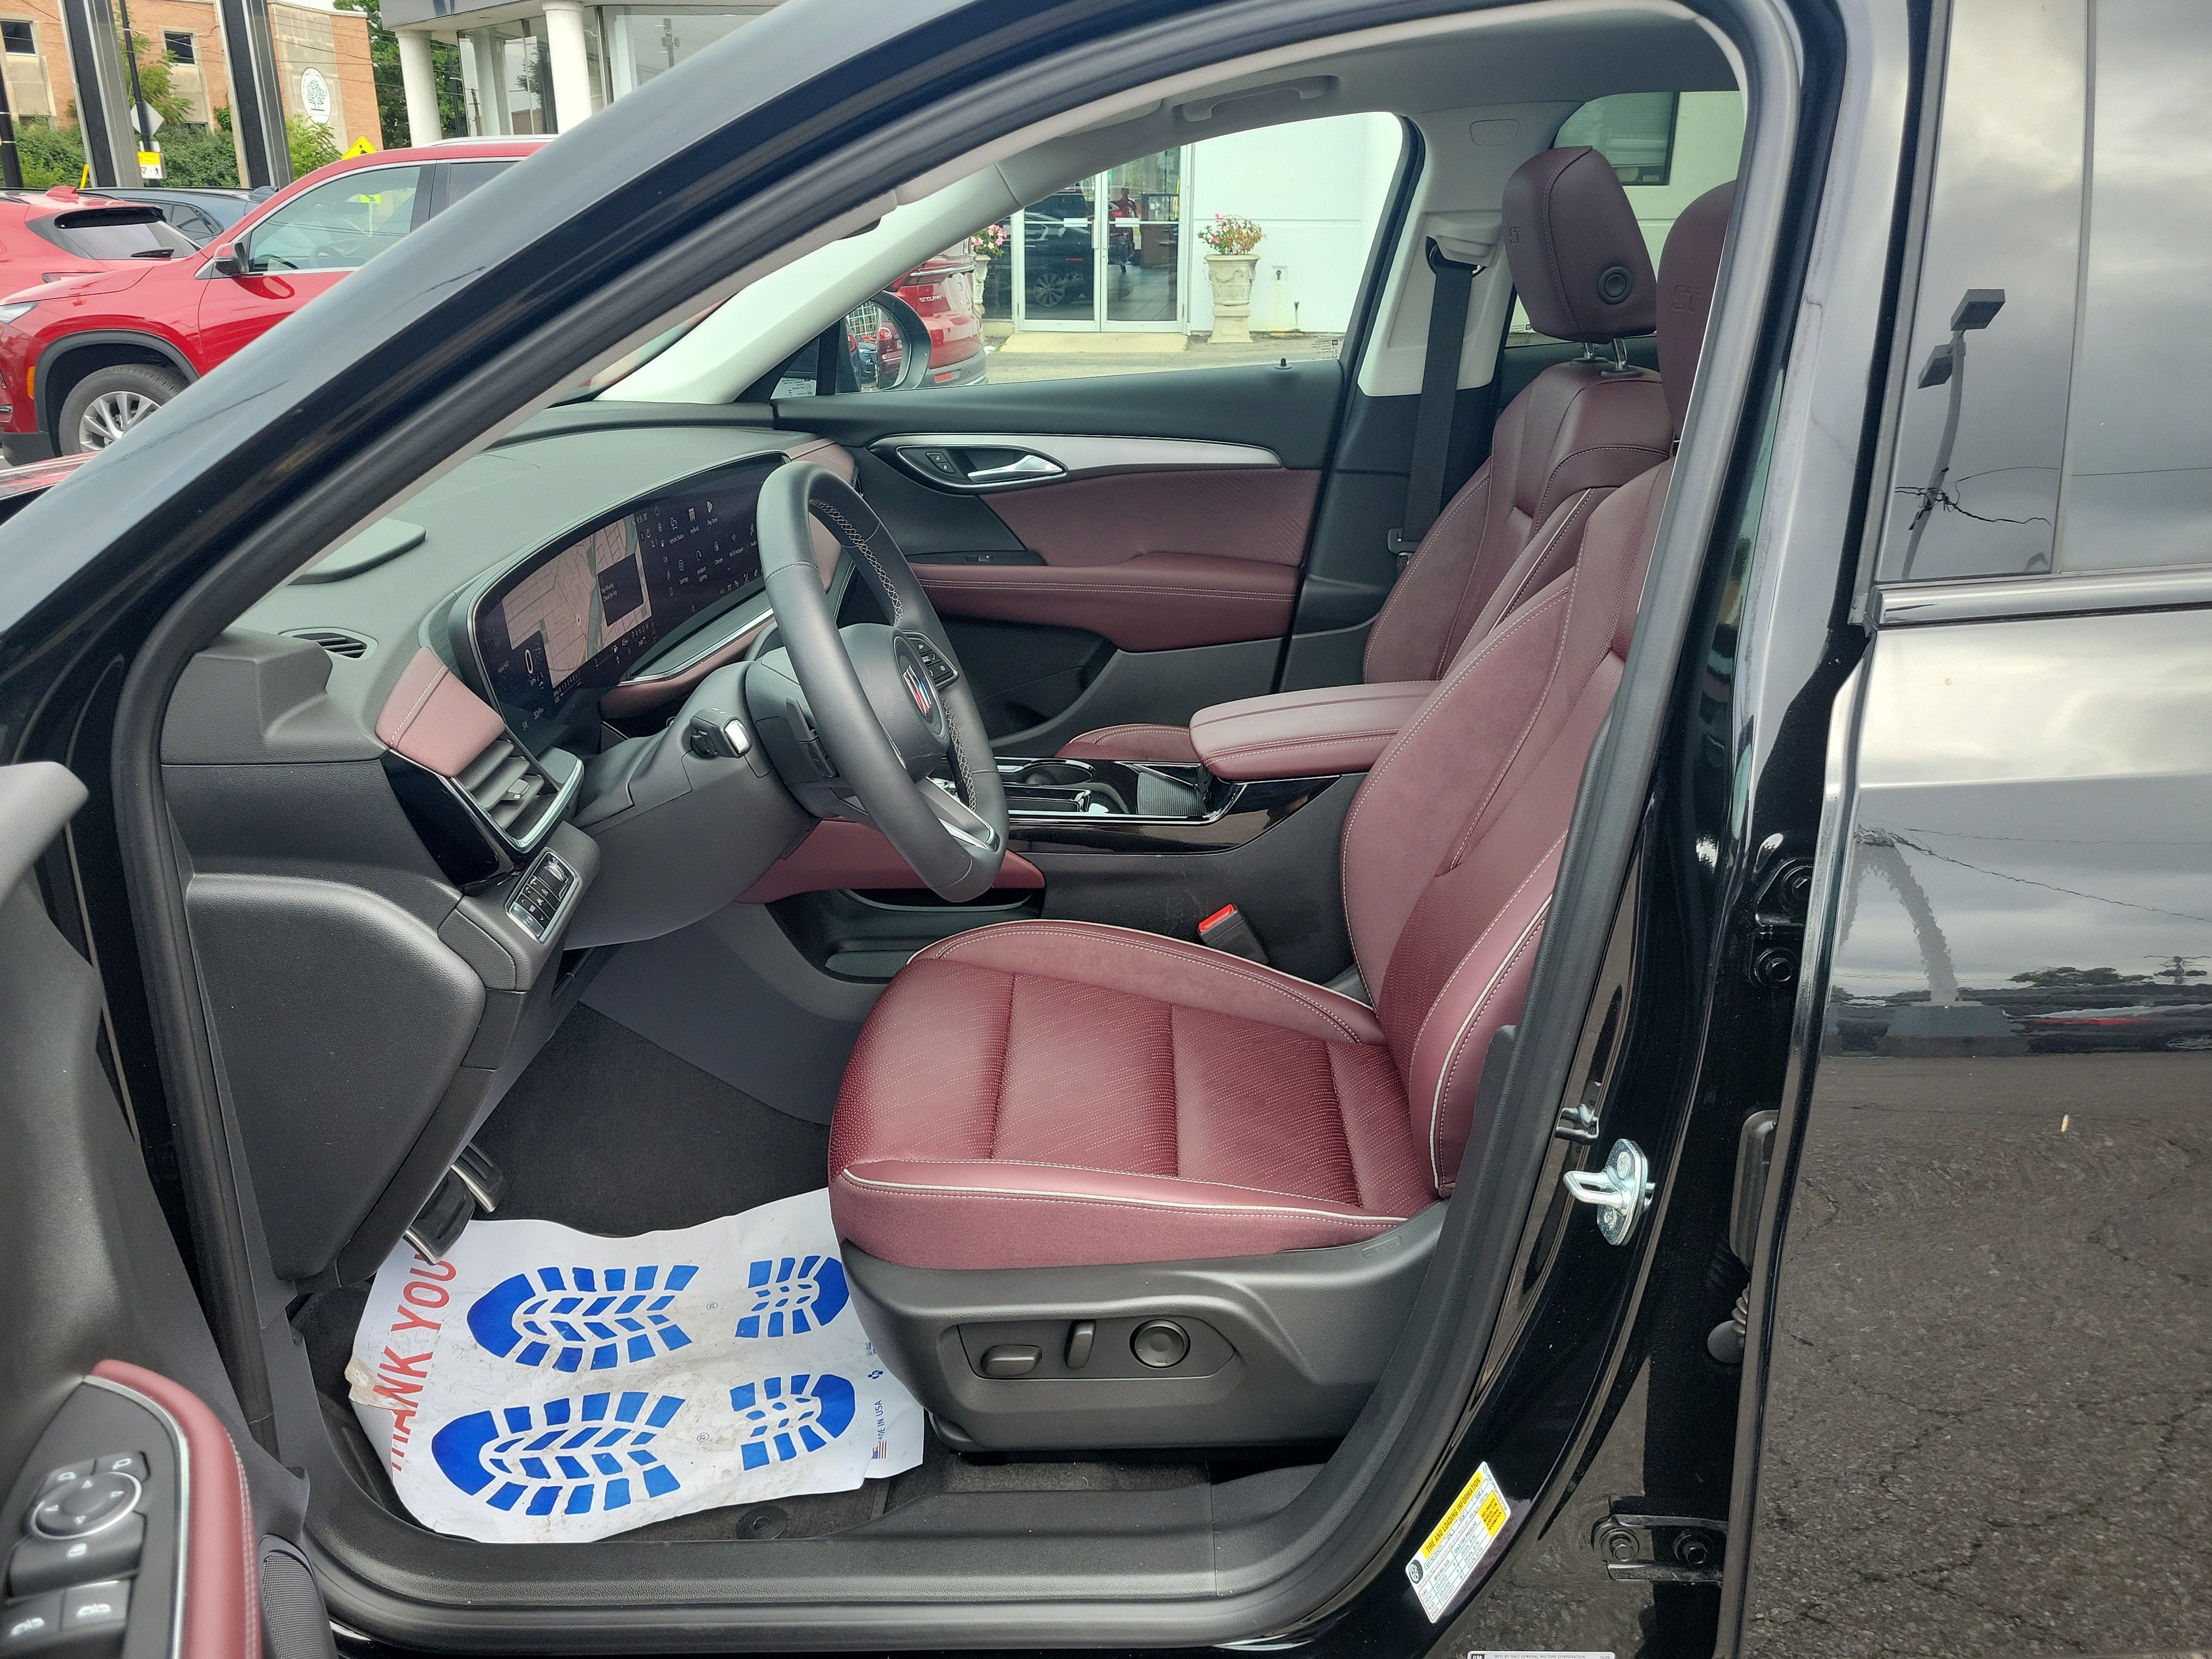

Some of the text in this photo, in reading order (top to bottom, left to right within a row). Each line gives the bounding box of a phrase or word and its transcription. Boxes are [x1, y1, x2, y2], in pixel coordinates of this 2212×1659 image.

[525, 650, 533, 674] 0
[380, 1254, 456, 1332] YOU
[874, 1400, 884, 1417] USA
[876, 1418, 884, 1427] IN
[1425, 1538, 1436, 1554] TIRE
[1434, 1527, 1443, 1543] AND
[1441, 1508, 1458, 1532] LOADING
[1455, 1476, 1481, 1512] INFORMATION
